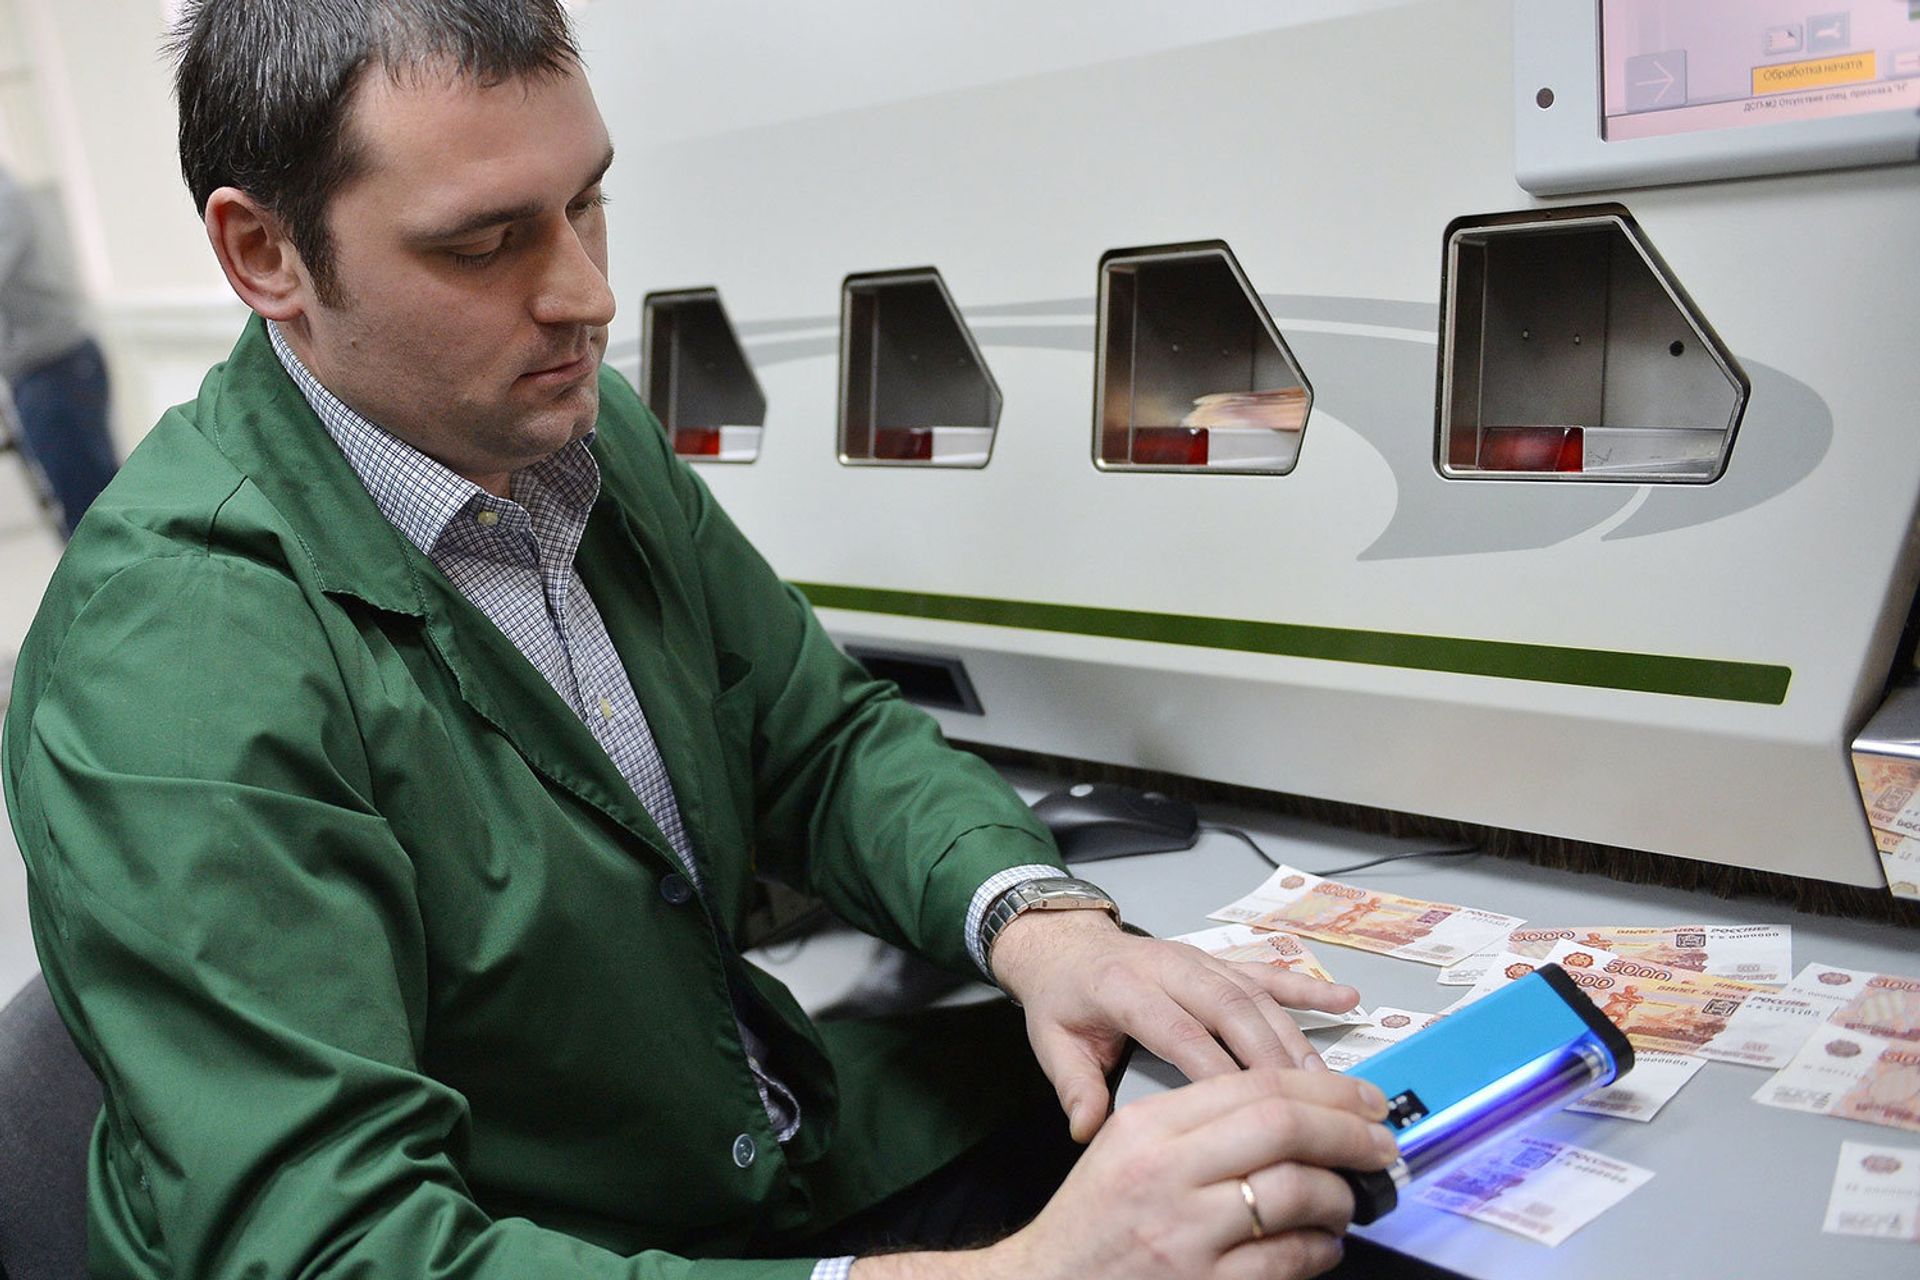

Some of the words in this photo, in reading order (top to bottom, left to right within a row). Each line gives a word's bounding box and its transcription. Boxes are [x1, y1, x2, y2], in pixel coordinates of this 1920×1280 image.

[1762, 64, 1822, 82] Обработка
[1824, 60, 1863, 73] начата
[1603, 959, 1672, 982] 5000
